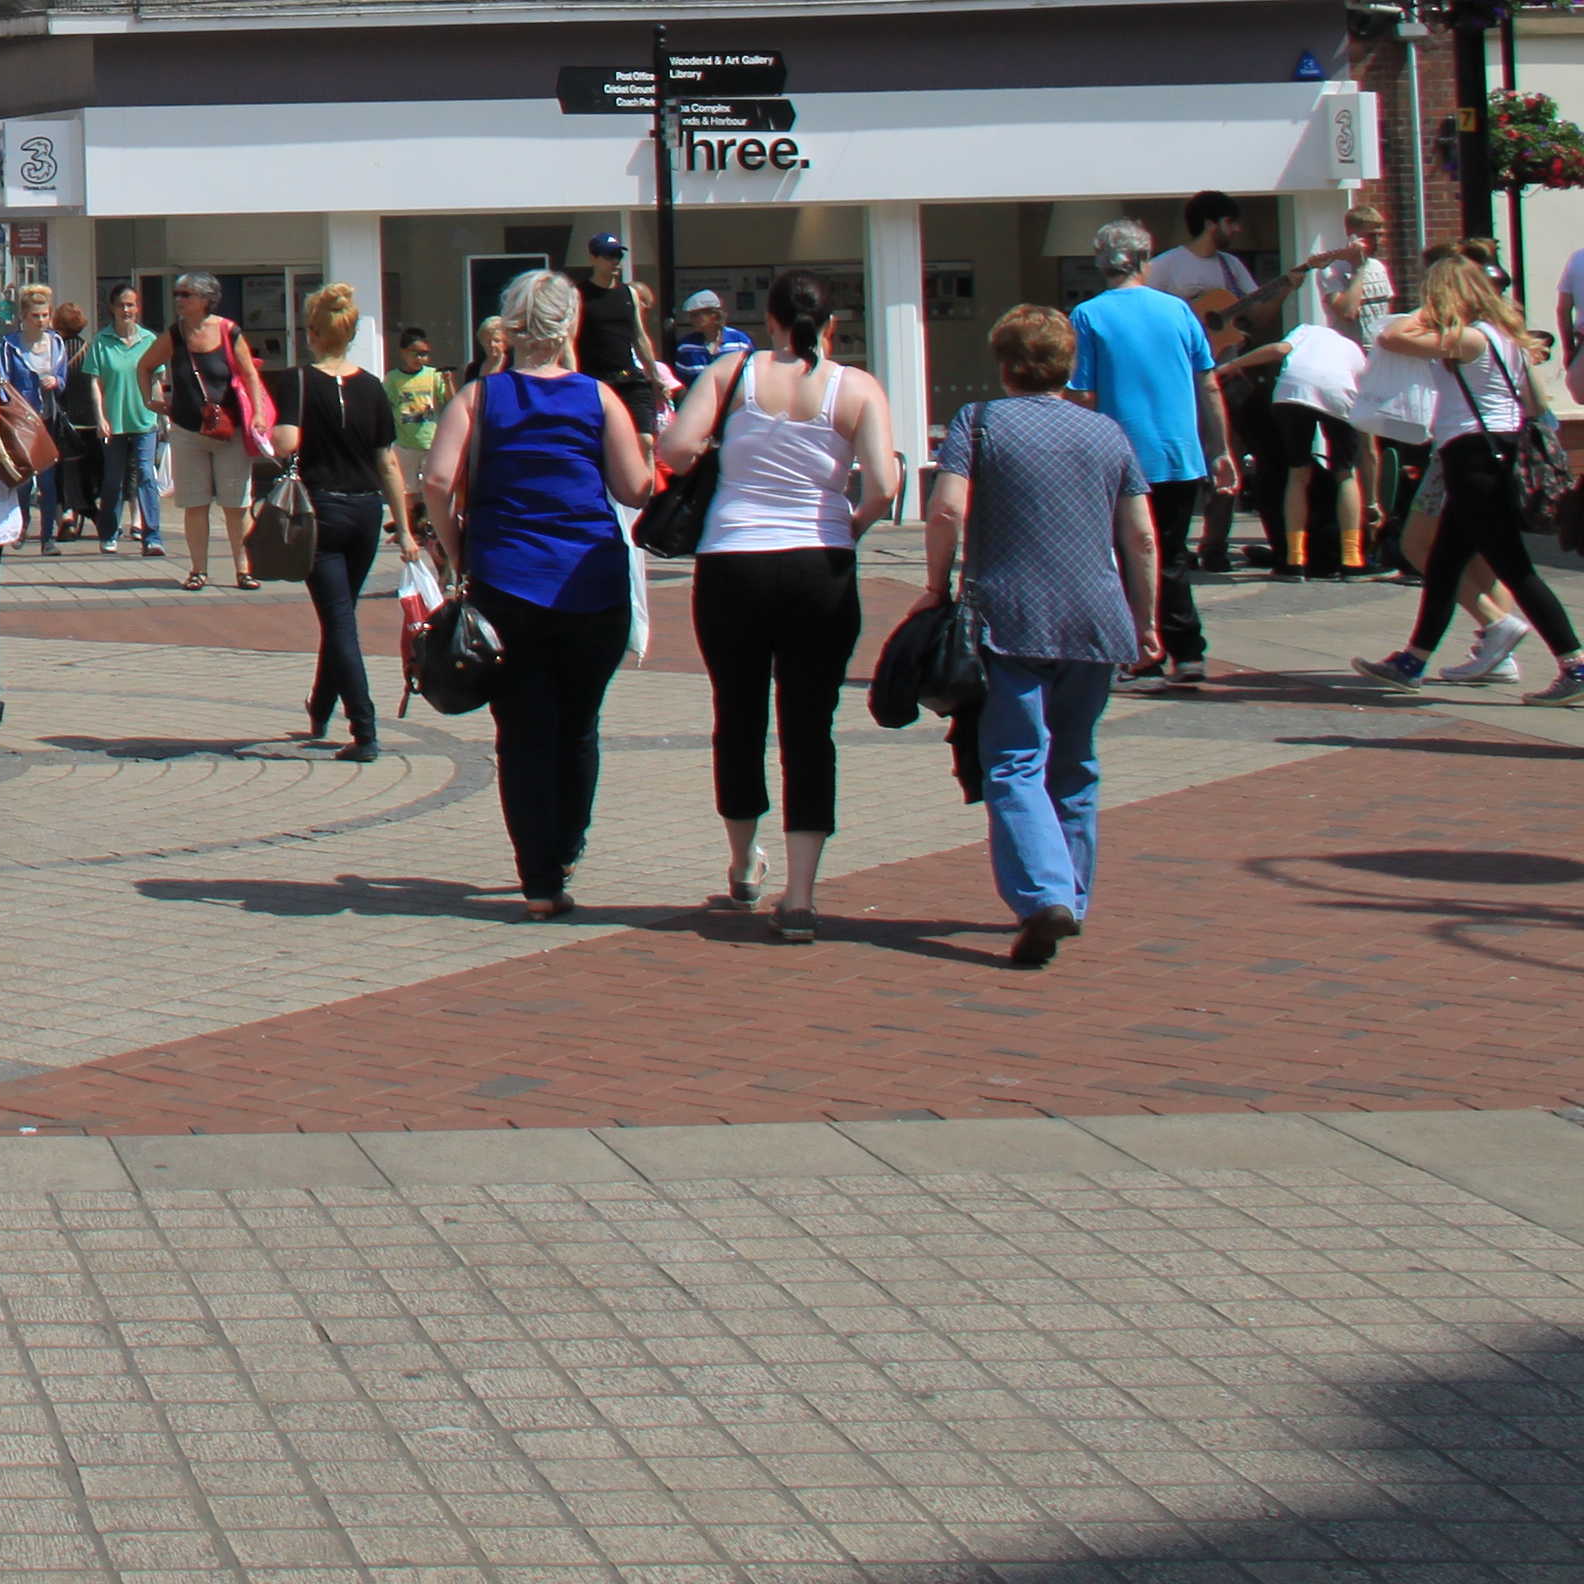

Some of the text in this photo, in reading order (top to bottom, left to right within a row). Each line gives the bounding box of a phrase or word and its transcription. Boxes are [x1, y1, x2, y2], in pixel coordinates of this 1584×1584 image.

[669, 56, 774, 67] Woodend & Art Gallery
[615, 71, 655, 81] Post Office
[669, 69, 702, 81] Library
[603, 84, 655, 94] Cricket Ground
[615, 97, 656, 106] Coach Park
[691, 103, 731, 114] Complex
[702, 117, 709, 125] &
[710, 116, 747, 126] Harbour
[1461, 110, 1473, 127] 7
[1335, 109, 1354, 157] 3
[685, 130, 811, 172] hree.
[20, 136, 57, 184] 3
